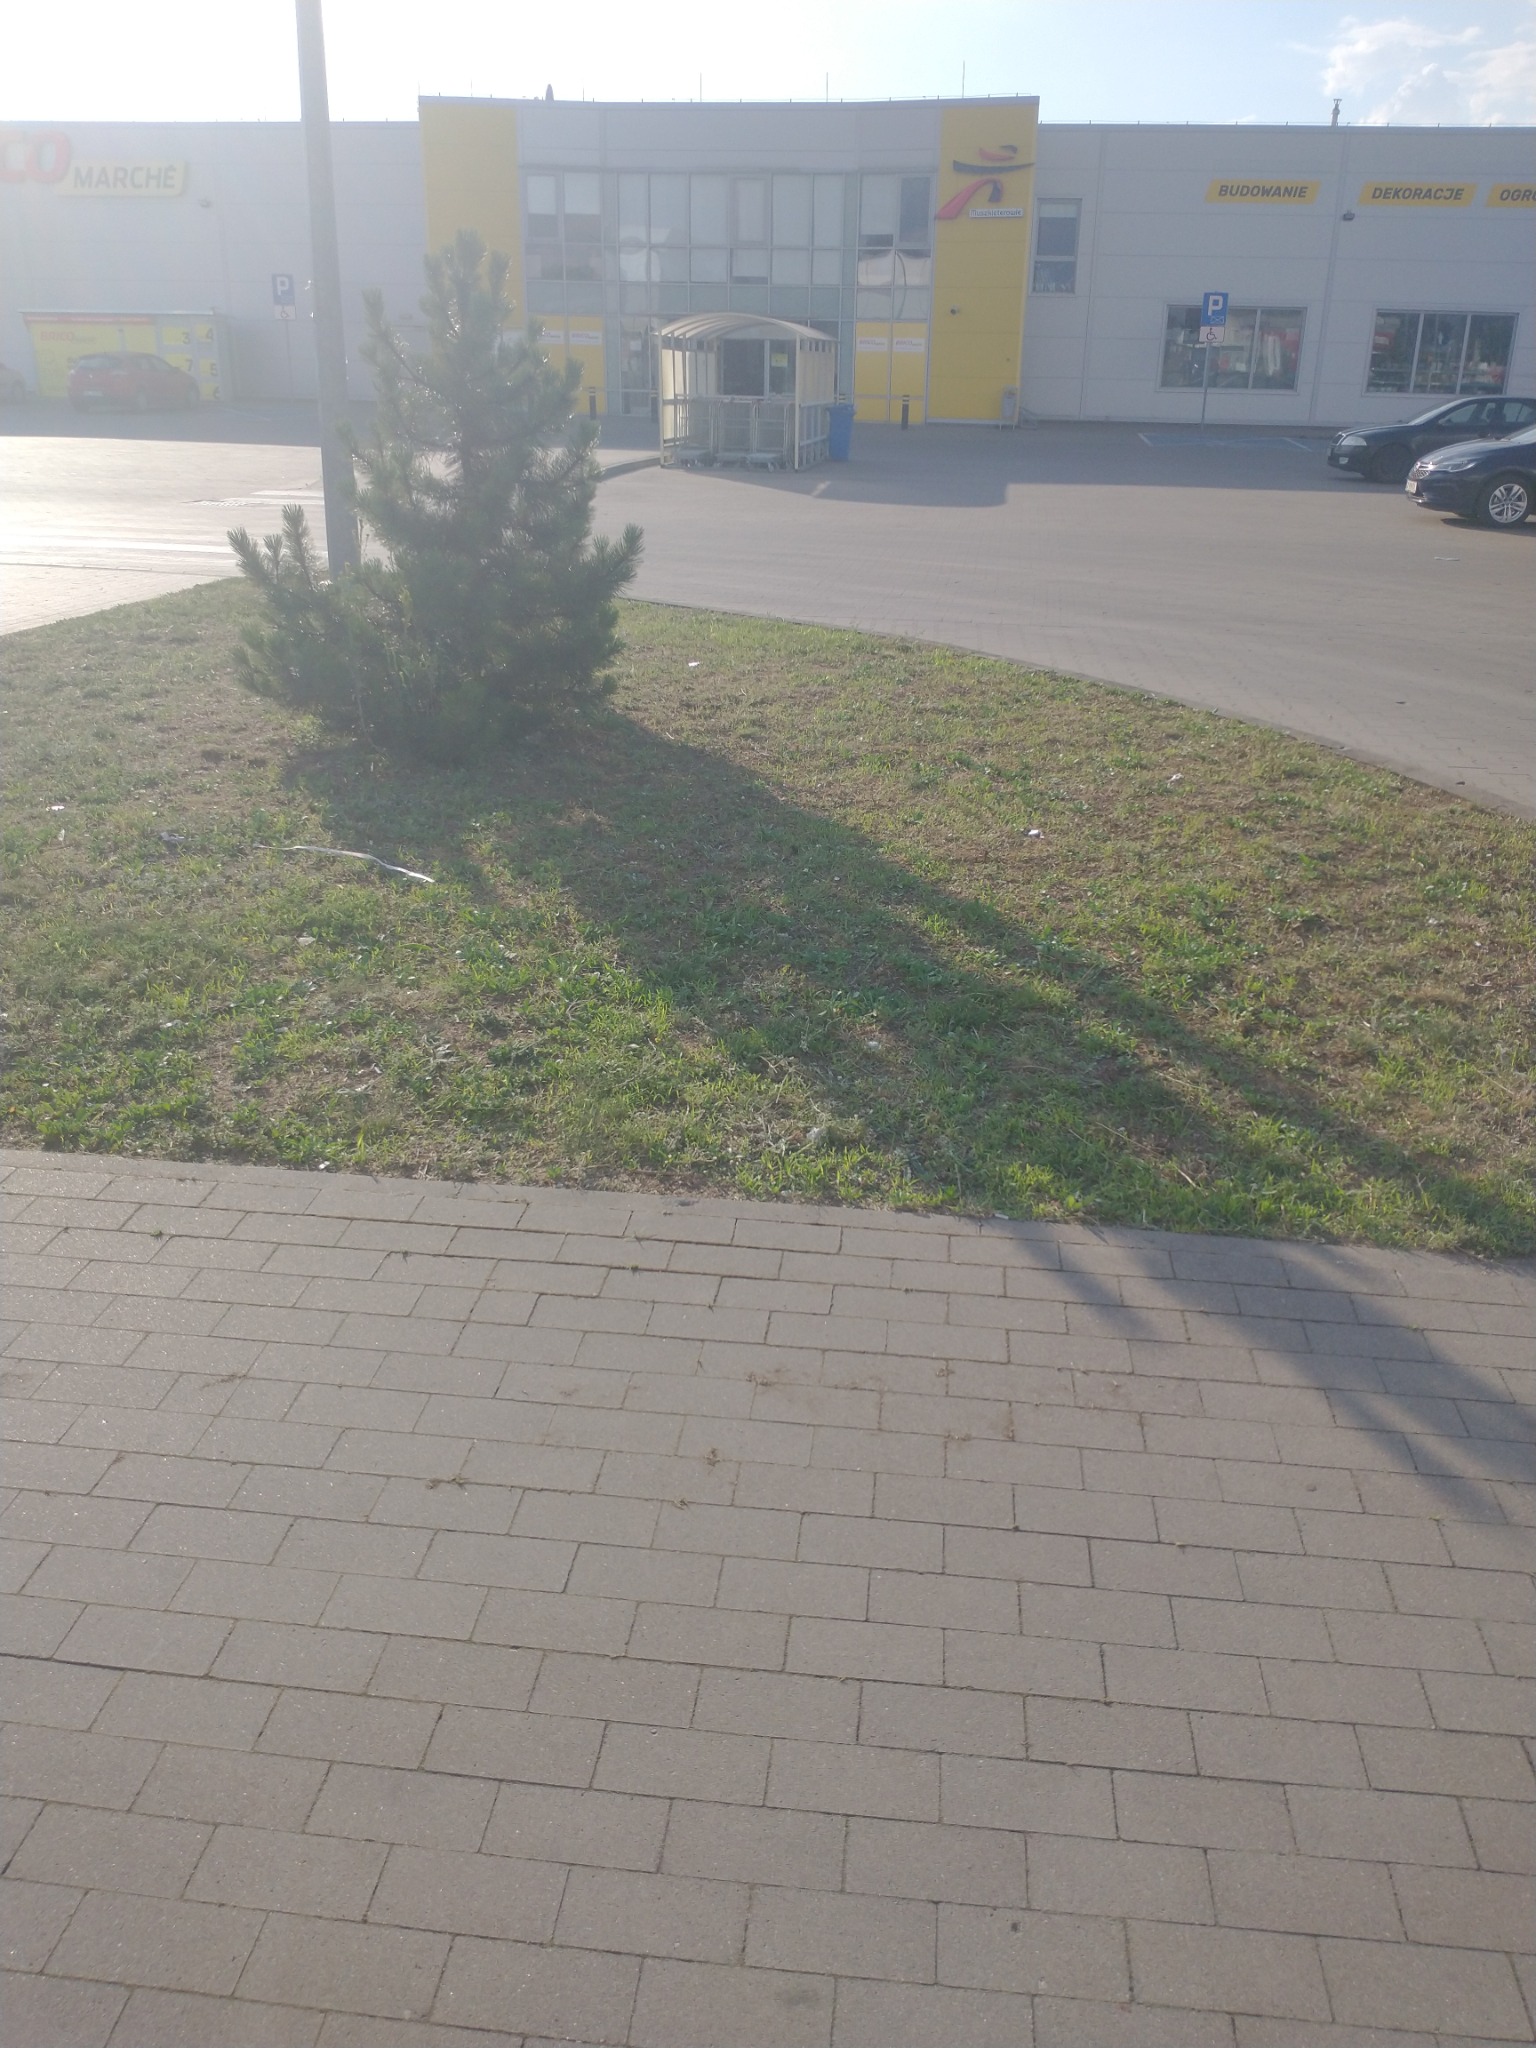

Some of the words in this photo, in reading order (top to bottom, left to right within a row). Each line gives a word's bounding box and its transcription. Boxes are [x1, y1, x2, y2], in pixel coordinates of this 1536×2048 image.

[1217, 184, 1309, 199] BUDOWANIE
[1371, 186, 1465, 201] DEKORACJE
[276, 276, 289, 296] P
[1208, 295, 1223, 316] P
[182, 331, 190, 345] 3
[185, 358, 193, 372] 7
